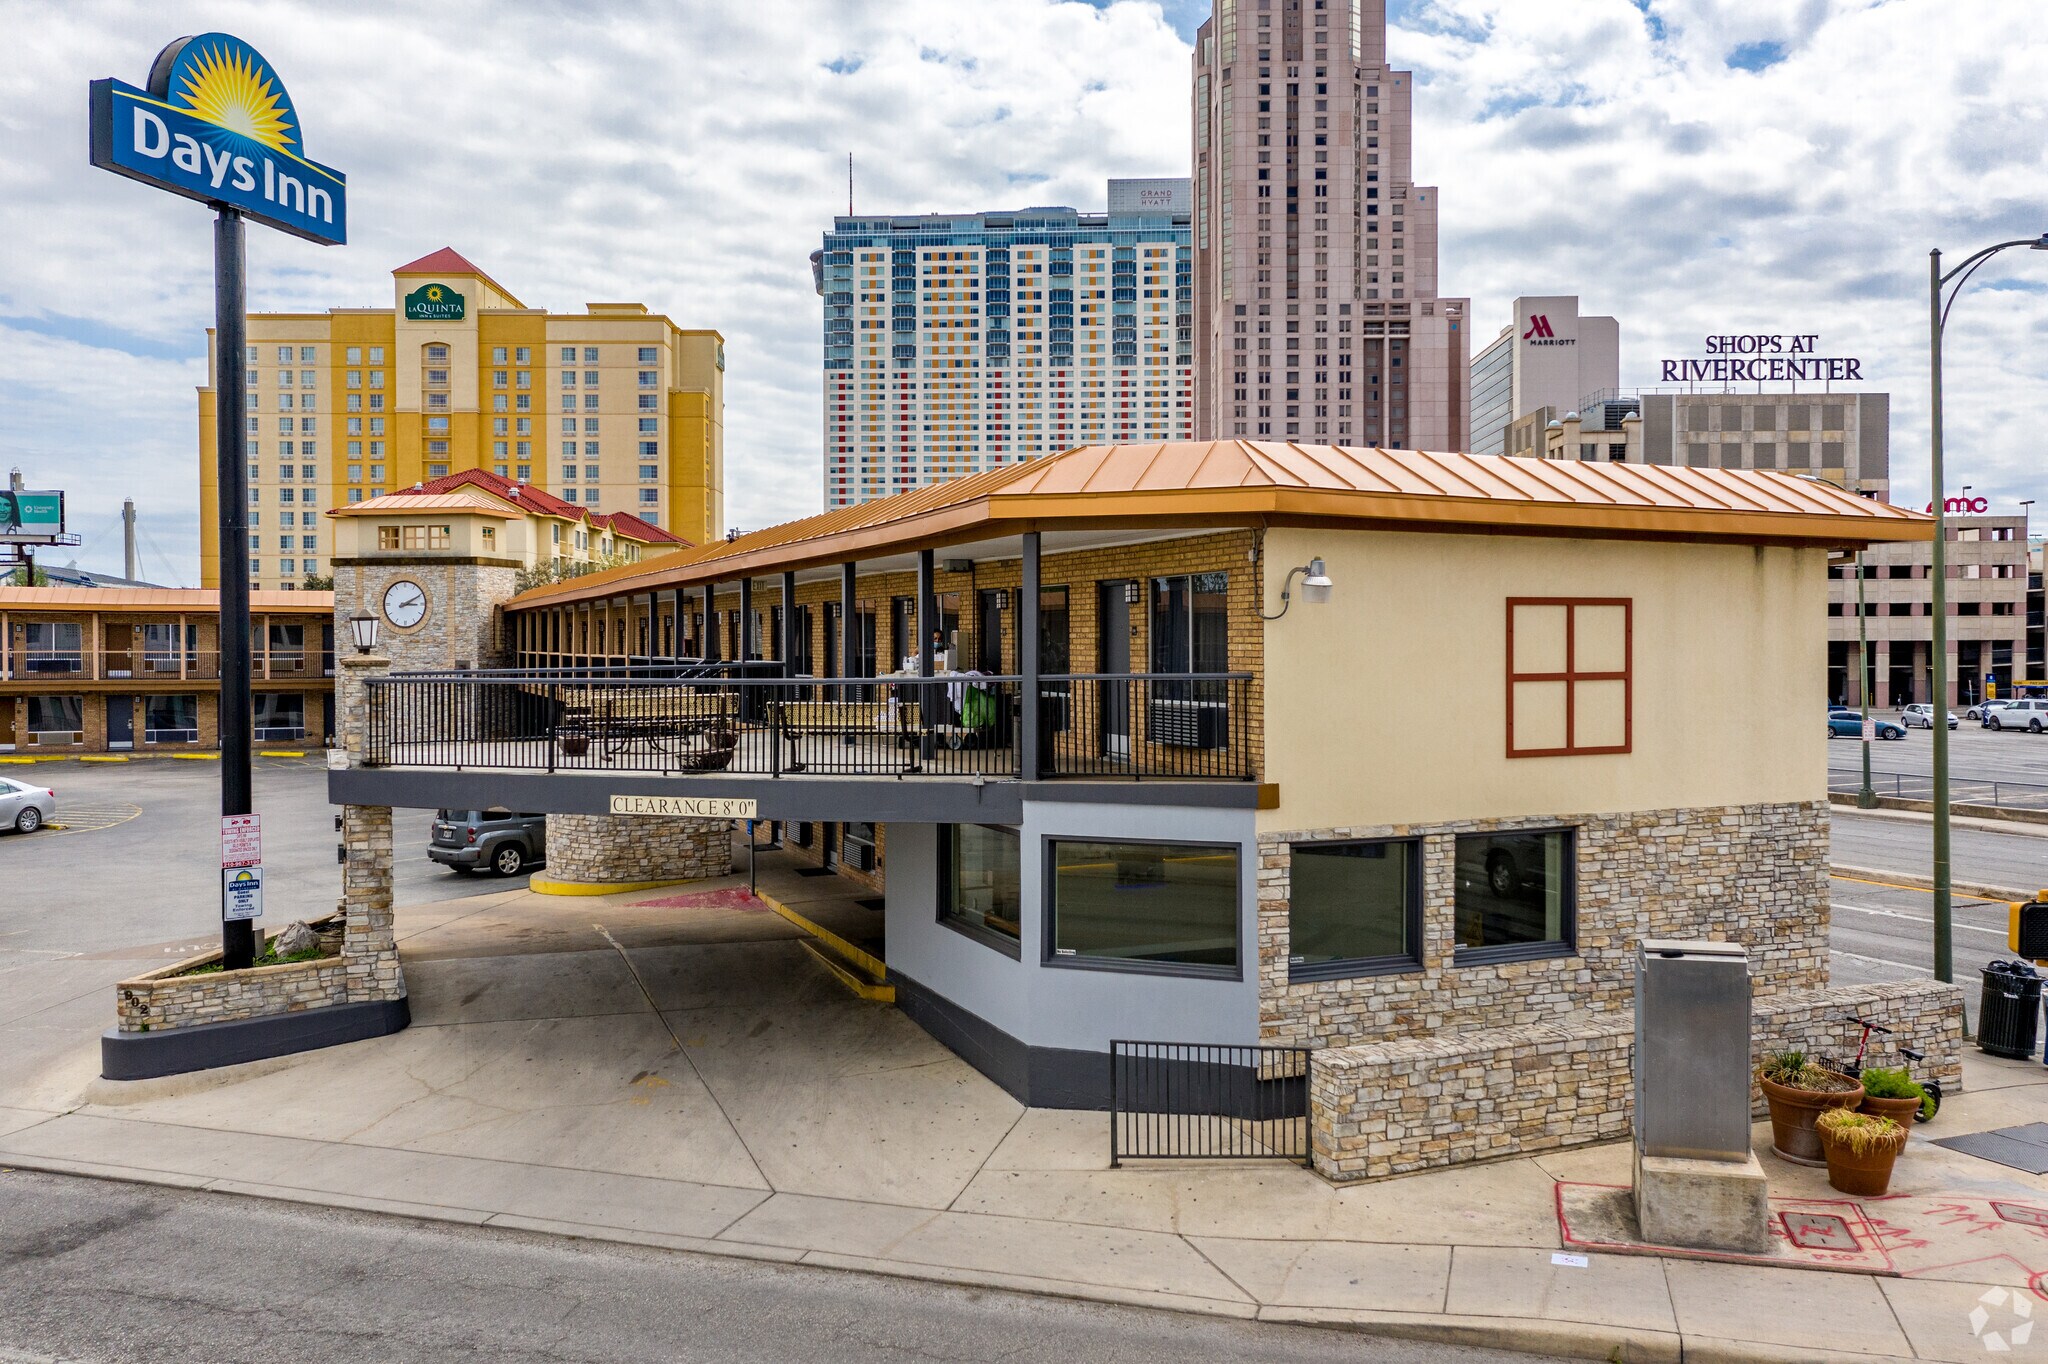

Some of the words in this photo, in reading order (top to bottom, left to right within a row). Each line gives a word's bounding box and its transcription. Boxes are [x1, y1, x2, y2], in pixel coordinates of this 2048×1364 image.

[133, 106, 255, 191] Days
[264, 158, 333, 224] Inn
[417, 302, 463, 315] QUINTA
[1705, 334, 1782, 354] SHOPS
[1789, 335, 1819, 353] AT
[1661, 357, 1864, 382] RIVERCENTER
[613, 797, 718, 816] CLEARANCE
[124, 990, 149, 1015] 902
